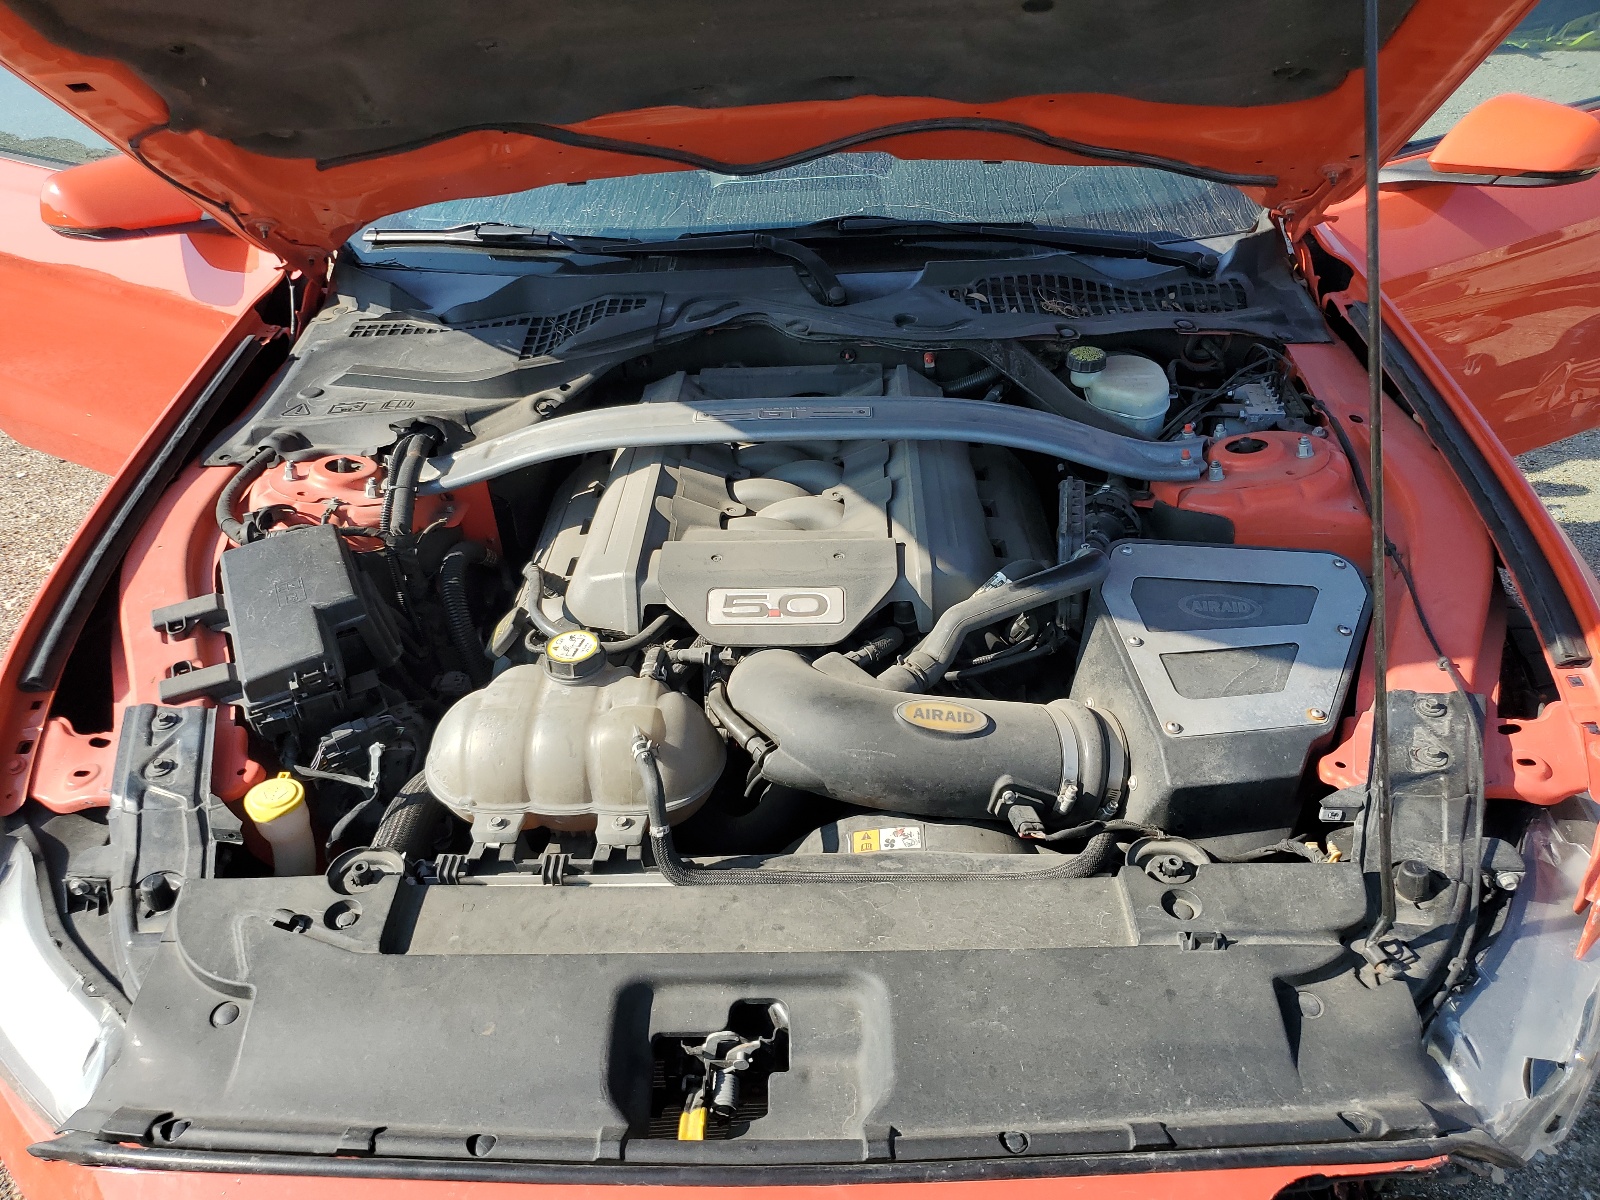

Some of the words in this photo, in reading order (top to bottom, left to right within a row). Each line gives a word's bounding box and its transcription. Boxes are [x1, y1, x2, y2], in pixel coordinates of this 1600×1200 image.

[722, 593, 831, 619] 5.0
[1192, 600, 1251, 613] AIRAID
[913, 707, 975, 724] AIRAID
